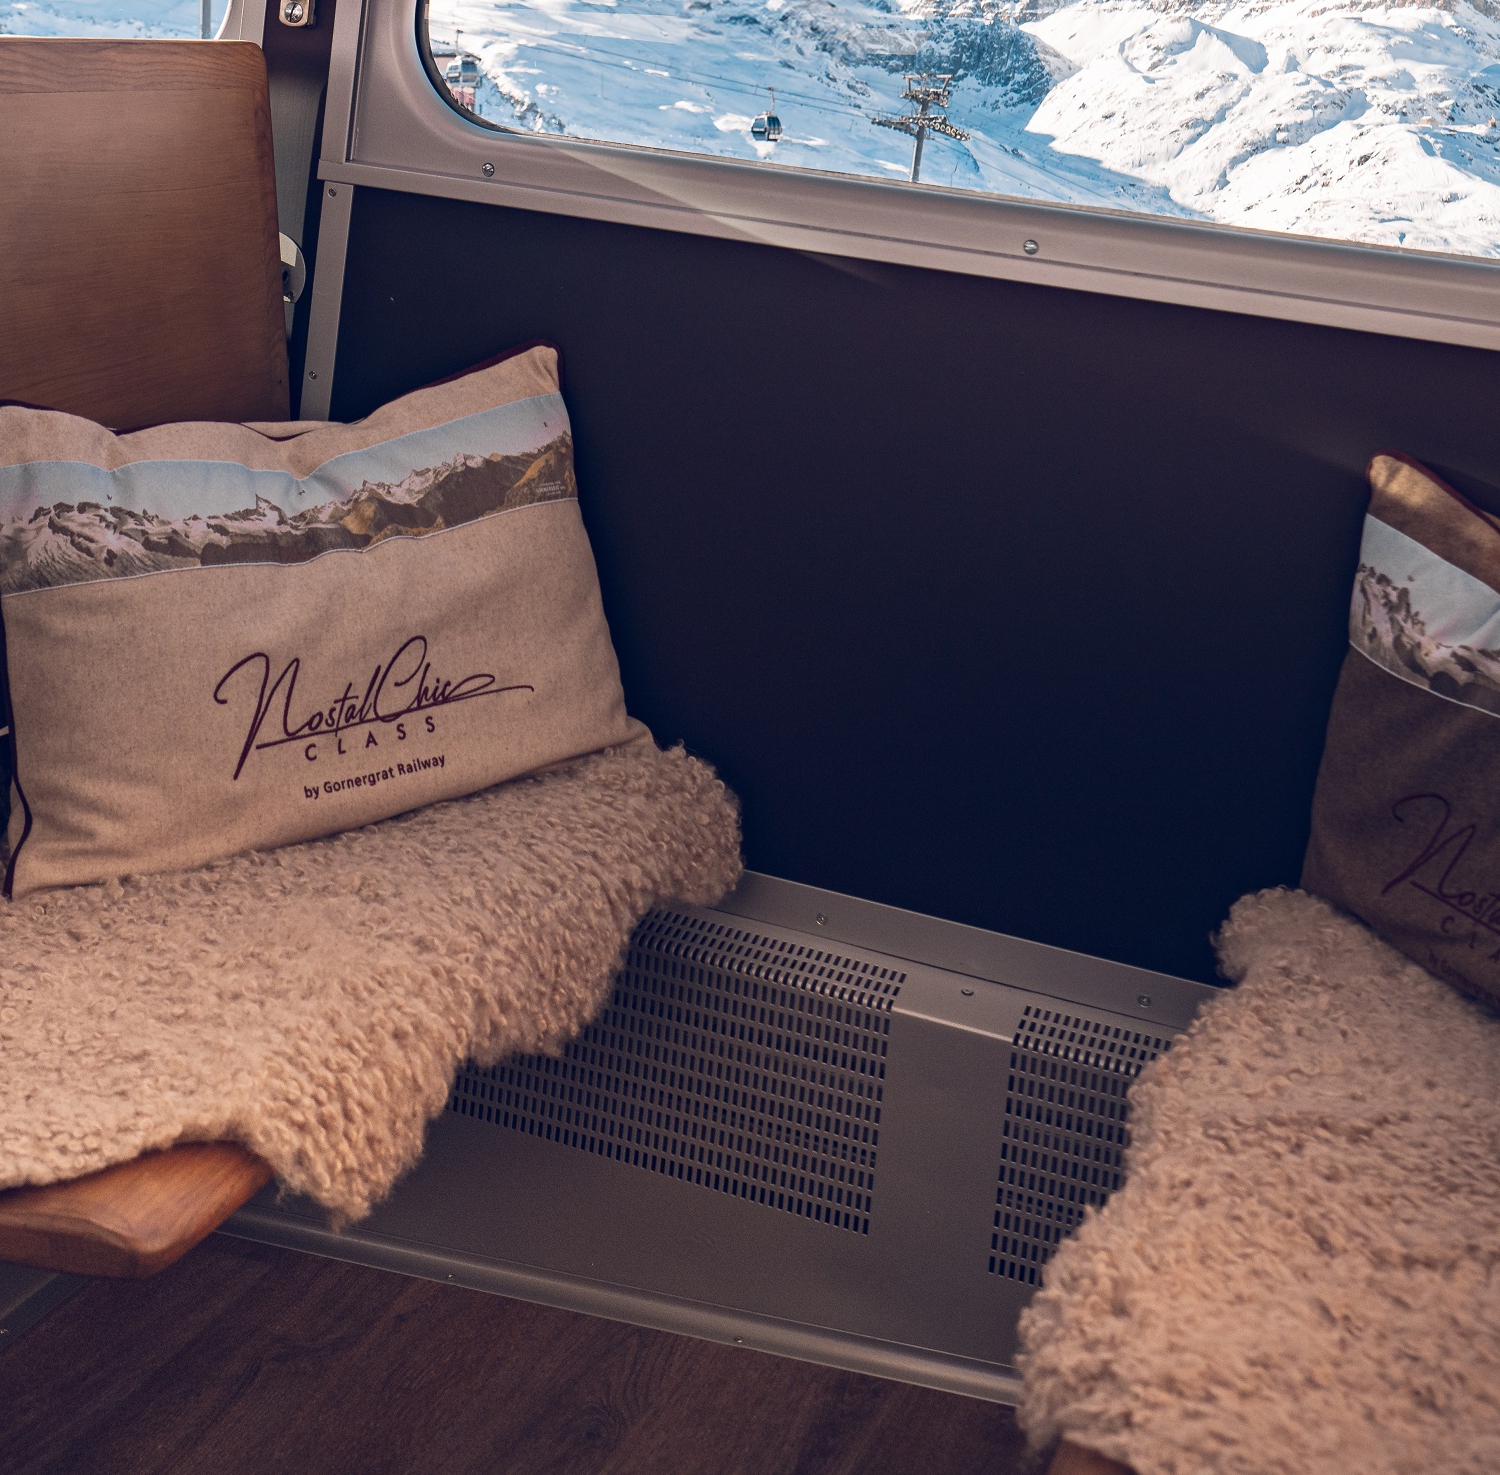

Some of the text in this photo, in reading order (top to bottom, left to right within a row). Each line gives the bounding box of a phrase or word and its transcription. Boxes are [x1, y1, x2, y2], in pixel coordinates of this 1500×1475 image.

[304, 715, 437, 762] CLASS
[303, 755, 446, 800] by Gornergrat Railway
